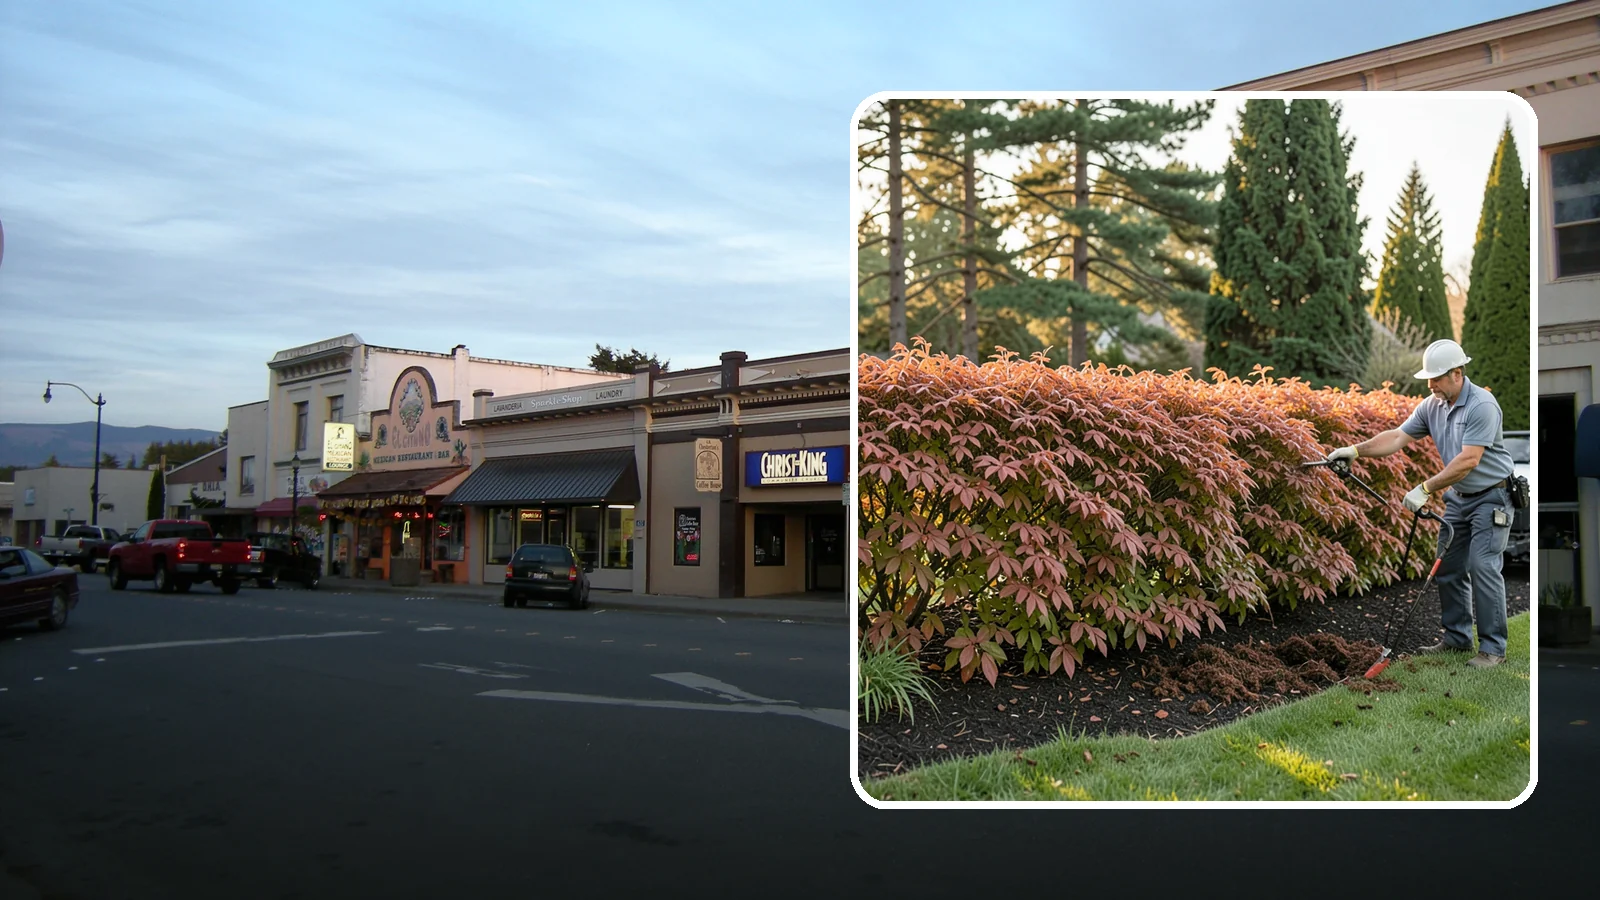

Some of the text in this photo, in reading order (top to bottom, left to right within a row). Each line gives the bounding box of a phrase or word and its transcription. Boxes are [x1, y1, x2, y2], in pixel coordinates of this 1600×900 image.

[493, 388, 623, 413] LAVANDERIA Sparkle Shop LAUNDRY
[373, 454, 396, 464] MEXICAN
[397, 451, 433, 463] RESTAURANT
[438, 450, 450, 459] BAR
[761, 452, 797, 478] CHRIST
[800, 450, 827, 477] KING
[696, 481, 722, 489] Coffee House
